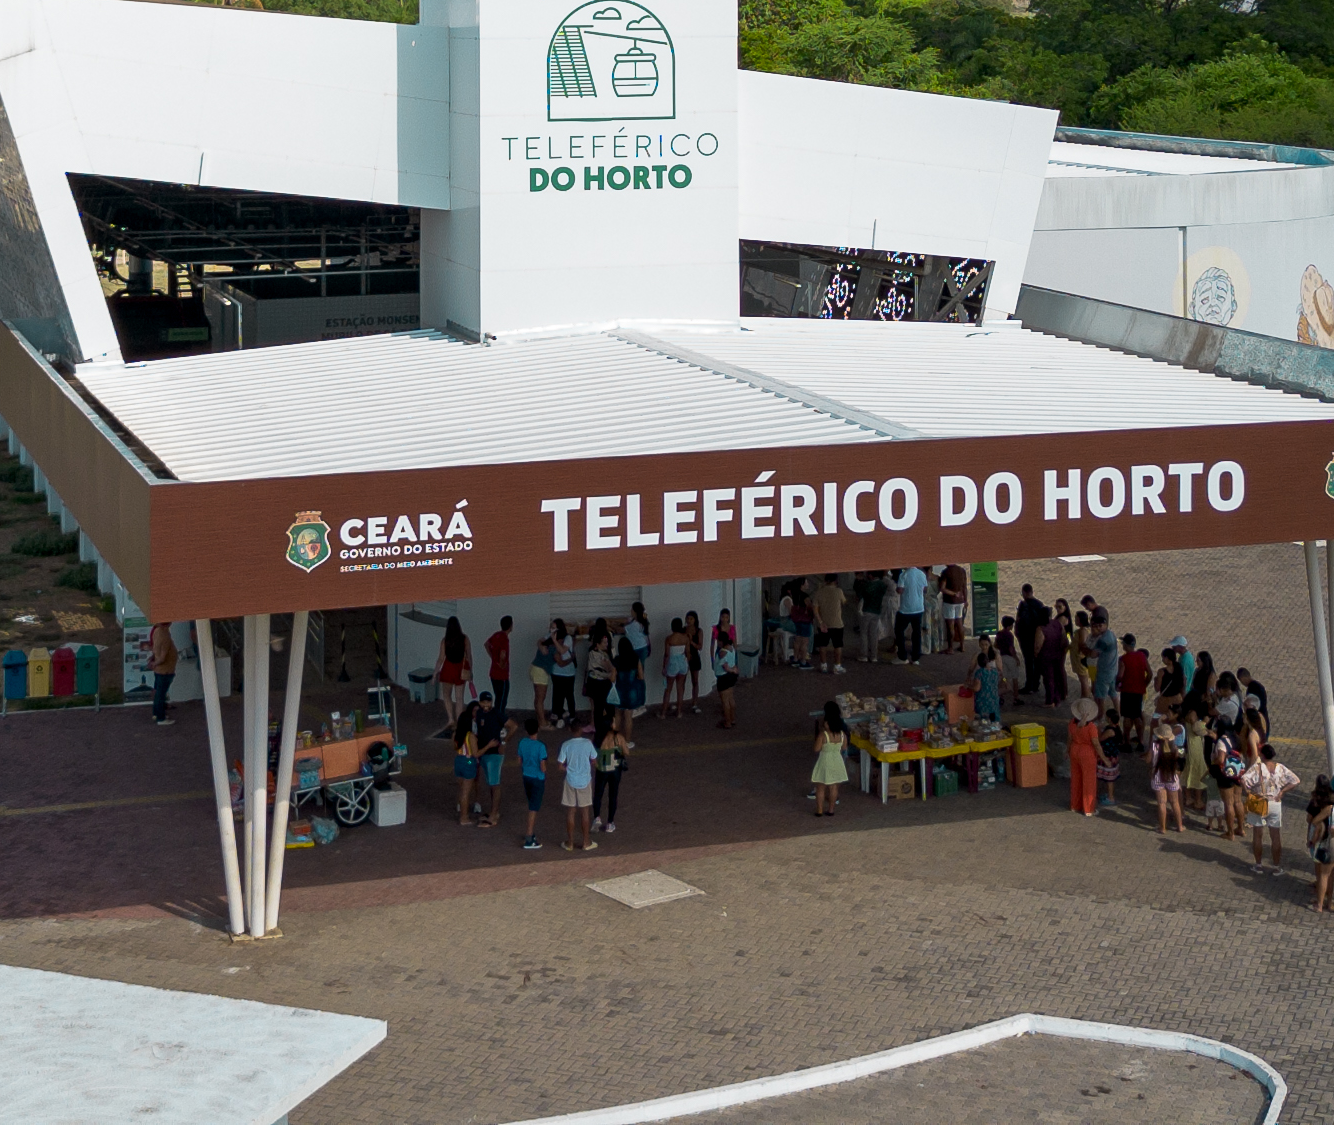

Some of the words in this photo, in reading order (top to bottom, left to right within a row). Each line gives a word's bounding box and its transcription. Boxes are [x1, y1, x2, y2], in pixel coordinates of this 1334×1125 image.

[501, 127, 719, 161] TELEFÉRICO
[529, 166, 576, 193] DO
[583, 164, 693, 191] HORTO
[325, 314, 375, 329] ESTAÇÃO
[540, 470, 919, 552] TELEFÉRICO
[939, 472, 1023, 527] DO
[1043, 460, 1245, 521] HORTO
[339, 498, 473, 546] CEARÁ
[339, 546, 402, 560] GOVERNO
[403, 544, 423, 555] DO
[425, 541, 474, 554] ESTADO
[340, 563, 383, 572] SECRETARIA
[396, 560, 416, 569] MEIO
[417, 558, 453, 567] AMBIENTE
